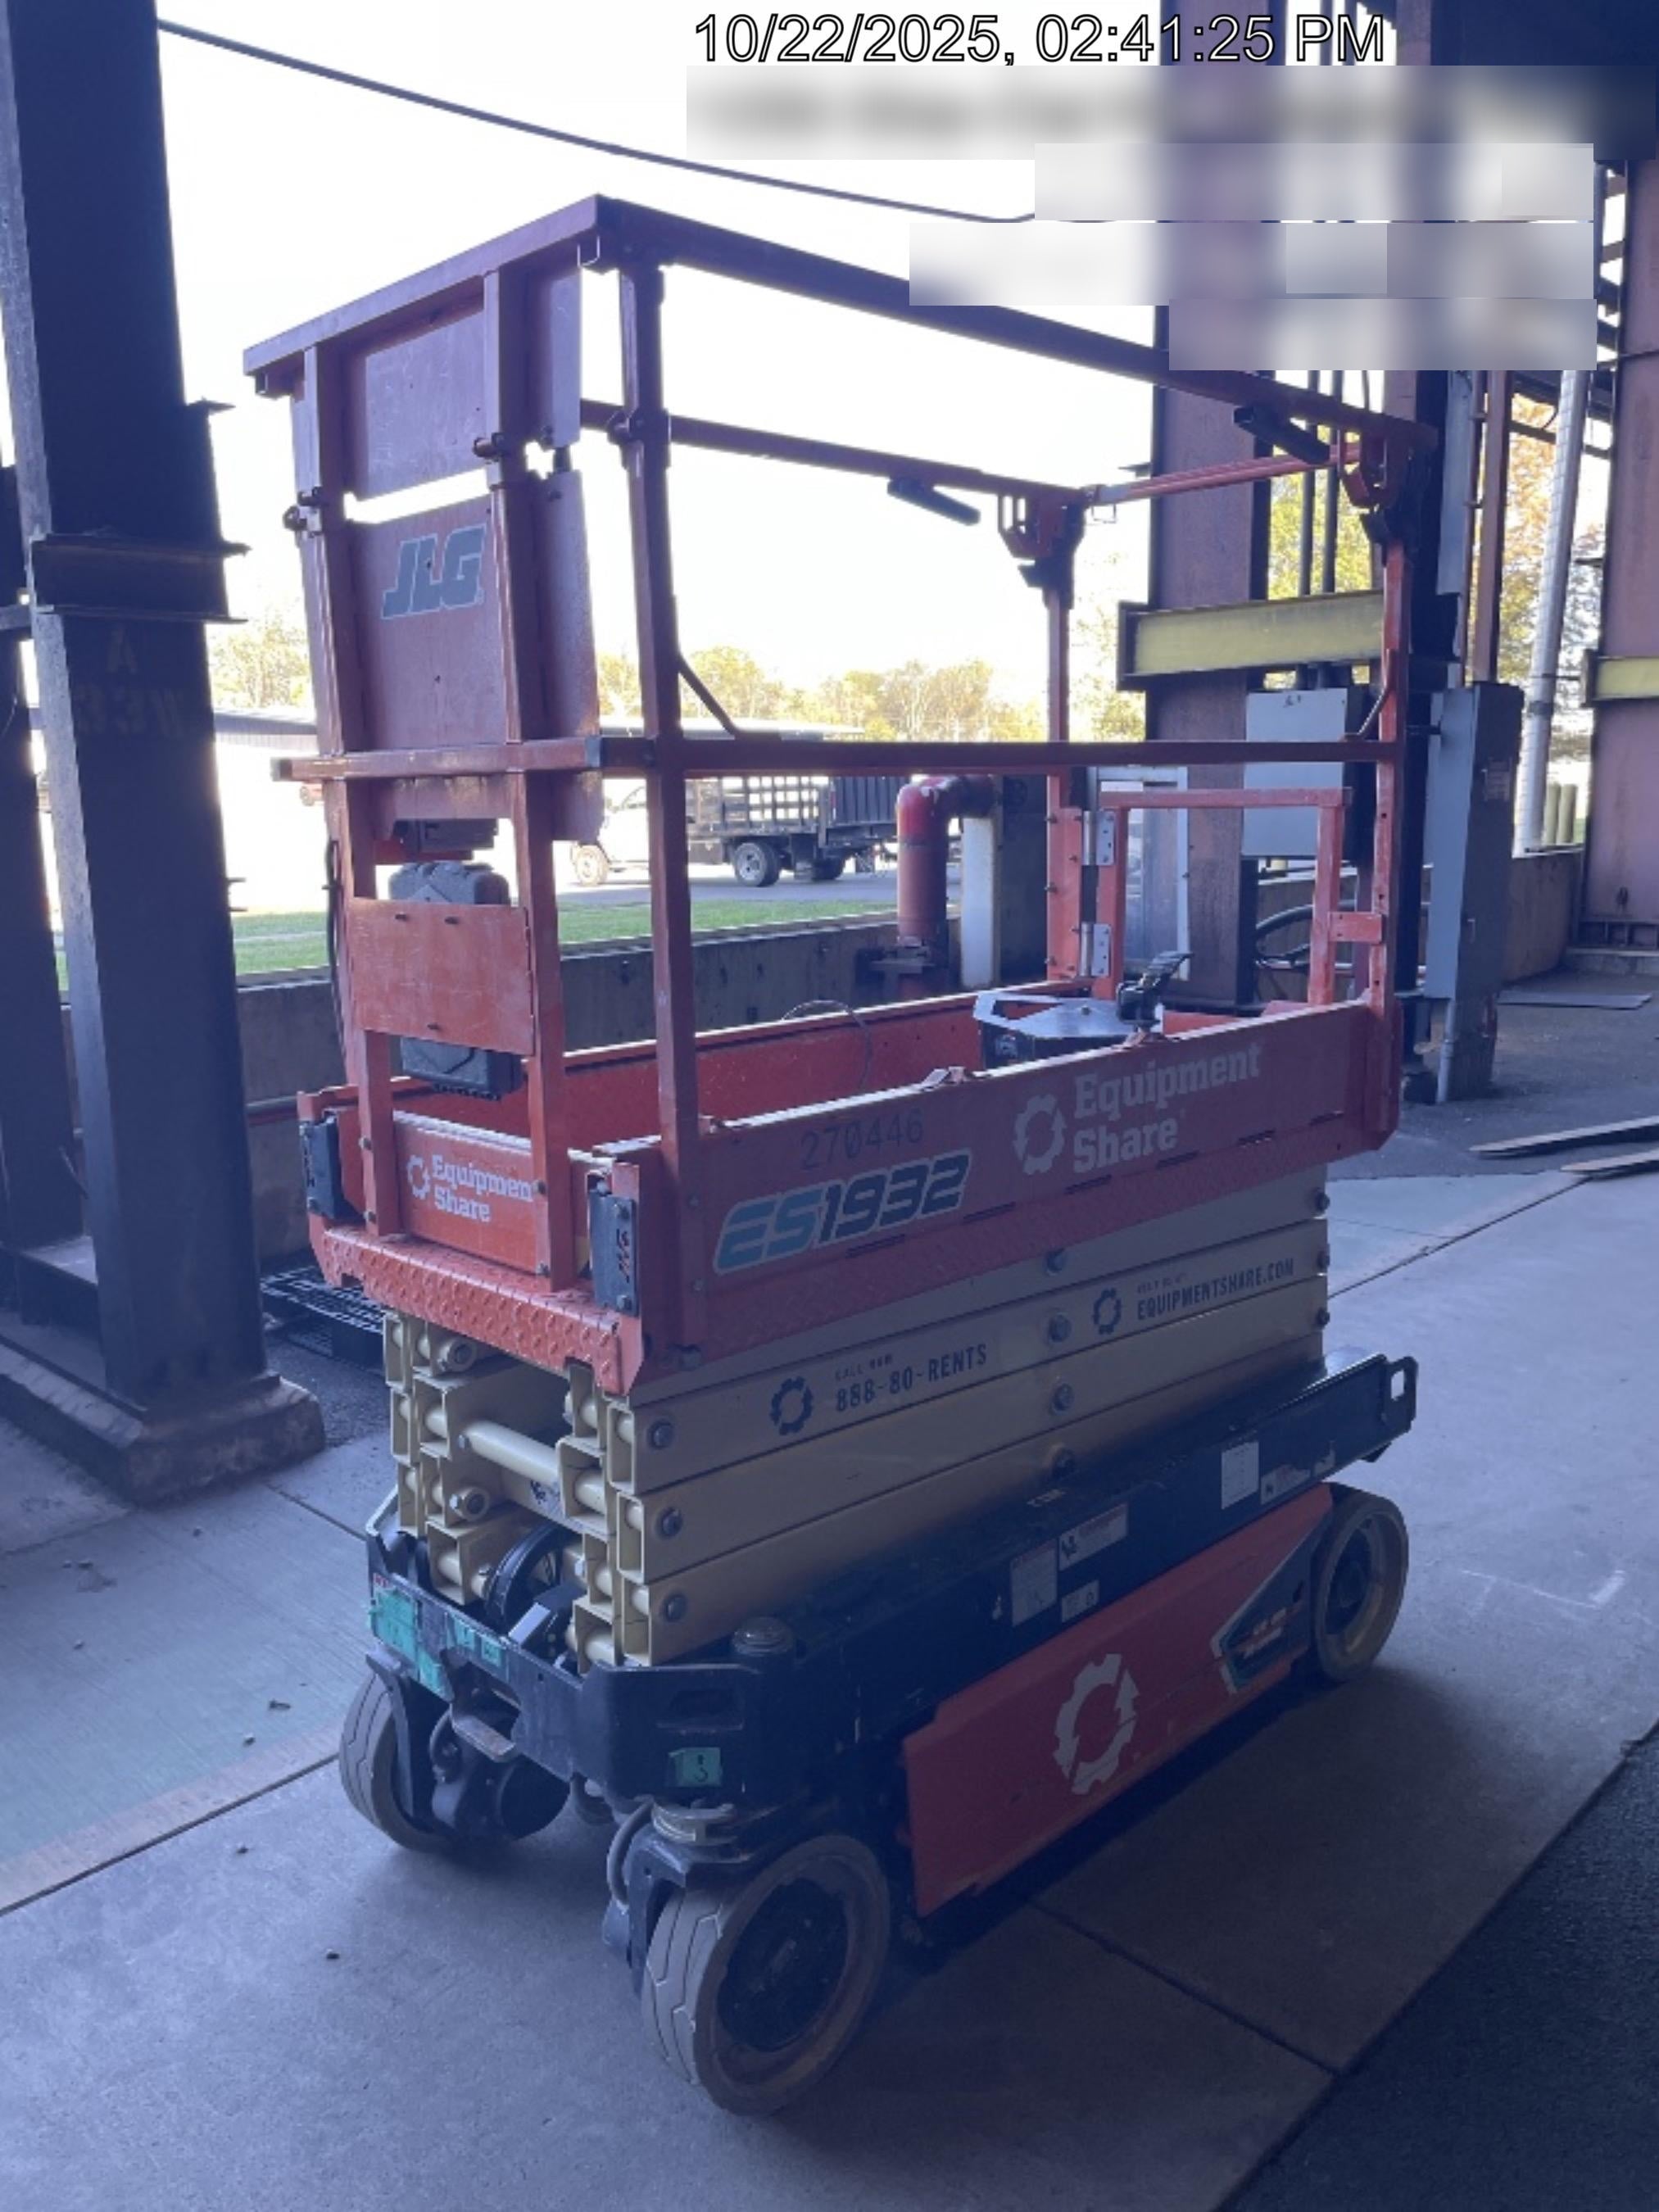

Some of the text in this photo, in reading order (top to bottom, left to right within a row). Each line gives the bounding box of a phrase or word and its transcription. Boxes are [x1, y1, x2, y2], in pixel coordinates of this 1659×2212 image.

[381, 525, 486, 620] JLG
[1074, 1045, 1260, 1117] Equipment
[800, 1108, 924, 1168] 270446
[1073, 1117, 1178, 1173] Share
[432, 1154, 533, 1203] Equipmen
[434, 1186, 491, 1222] Share
[714, 1149, 972, 1273] ES1932
[1137, 1258, 1294, 1321] EQUIPMENTSHARE.COM
[835, 1344, 987, 1412] 888-80-RENTS
